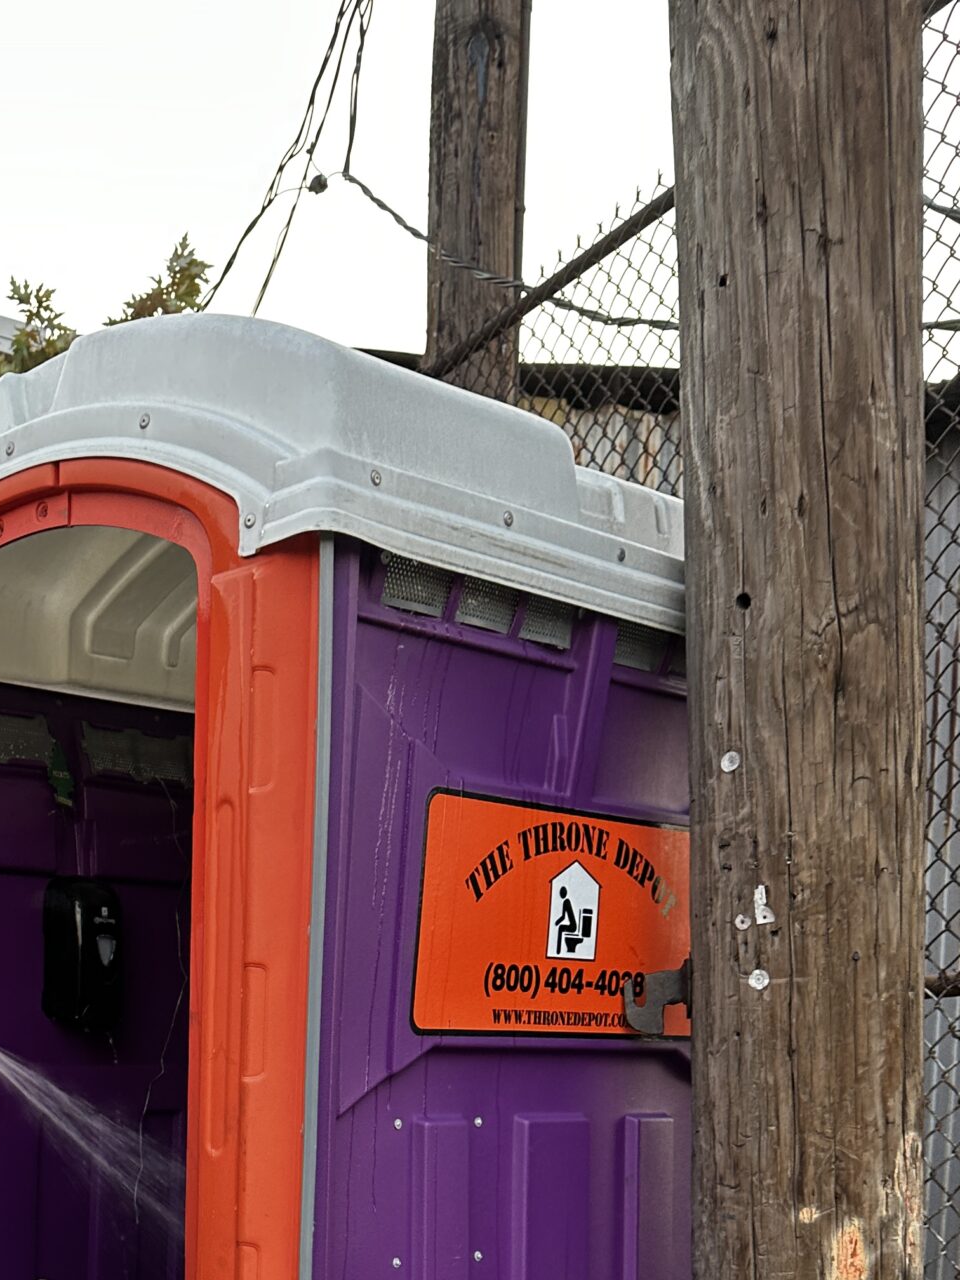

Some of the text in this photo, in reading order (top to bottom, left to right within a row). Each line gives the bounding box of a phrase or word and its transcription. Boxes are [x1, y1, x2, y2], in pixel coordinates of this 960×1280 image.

[465, 840, 514, 902] THE
[517, 821, 610, 862] THRONE
[484, 962, 540, 999] (800)
[492, 1008, 632, 1028] WWW.THRONEDEPOT.CO
